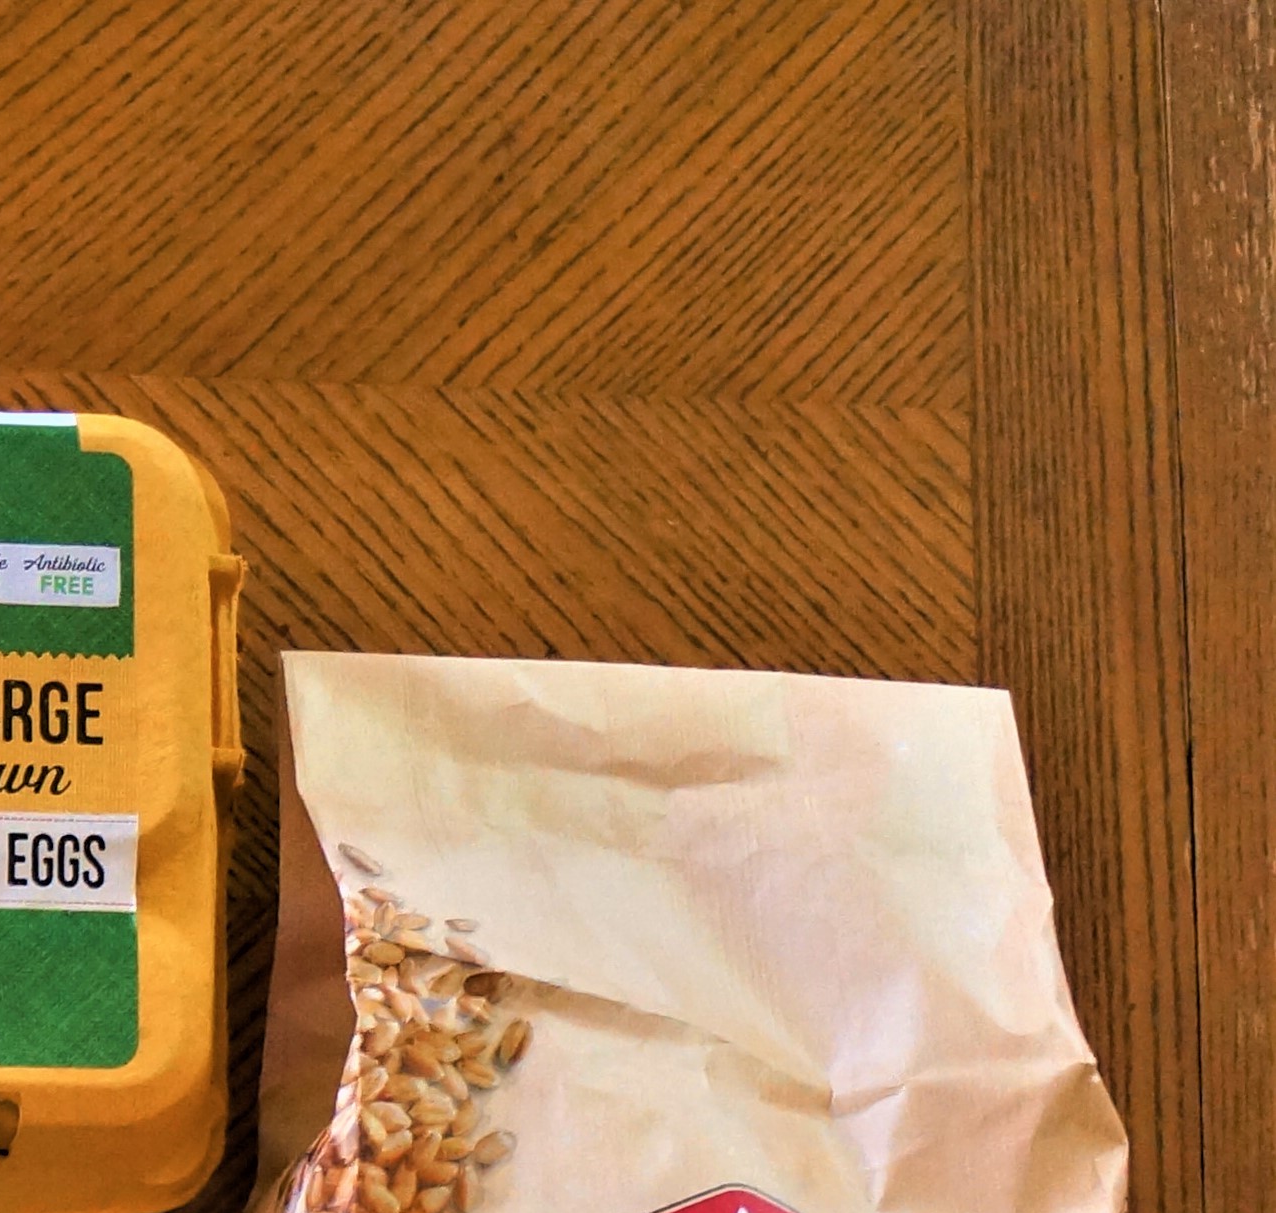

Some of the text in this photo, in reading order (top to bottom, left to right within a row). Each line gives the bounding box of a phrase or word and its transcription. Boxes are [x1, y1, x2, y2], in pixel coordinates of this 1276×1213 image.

[24, 552, 106, 573] Antibiotic
[40, 575, 94, 595] FREE
[7, 832, 107, 890] EGGS
